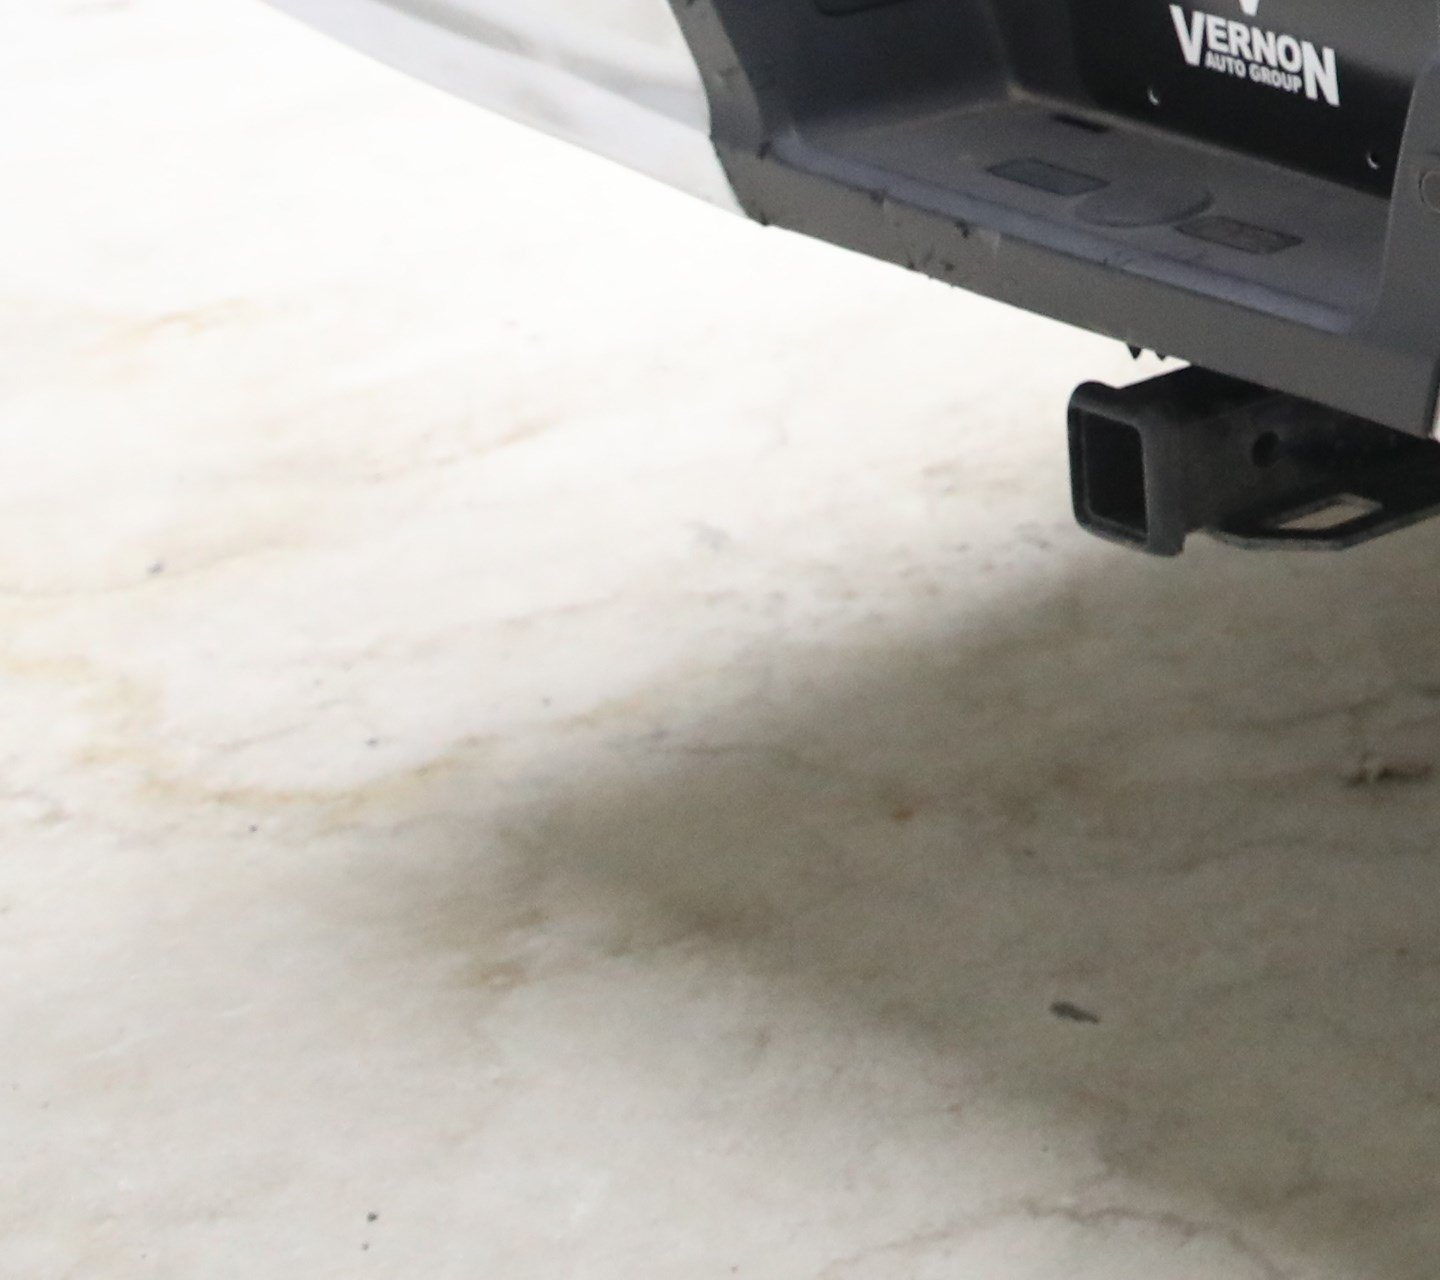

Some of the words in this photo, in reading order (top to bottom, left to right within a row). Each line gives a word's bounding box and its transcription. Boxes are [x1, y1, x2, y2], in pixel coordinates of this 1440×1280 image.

[1170, 4, 1340, 107] VERNON
[1206, 54, 1246, 79] AUTO
[1250, 64, 1302, 93] GROUP
